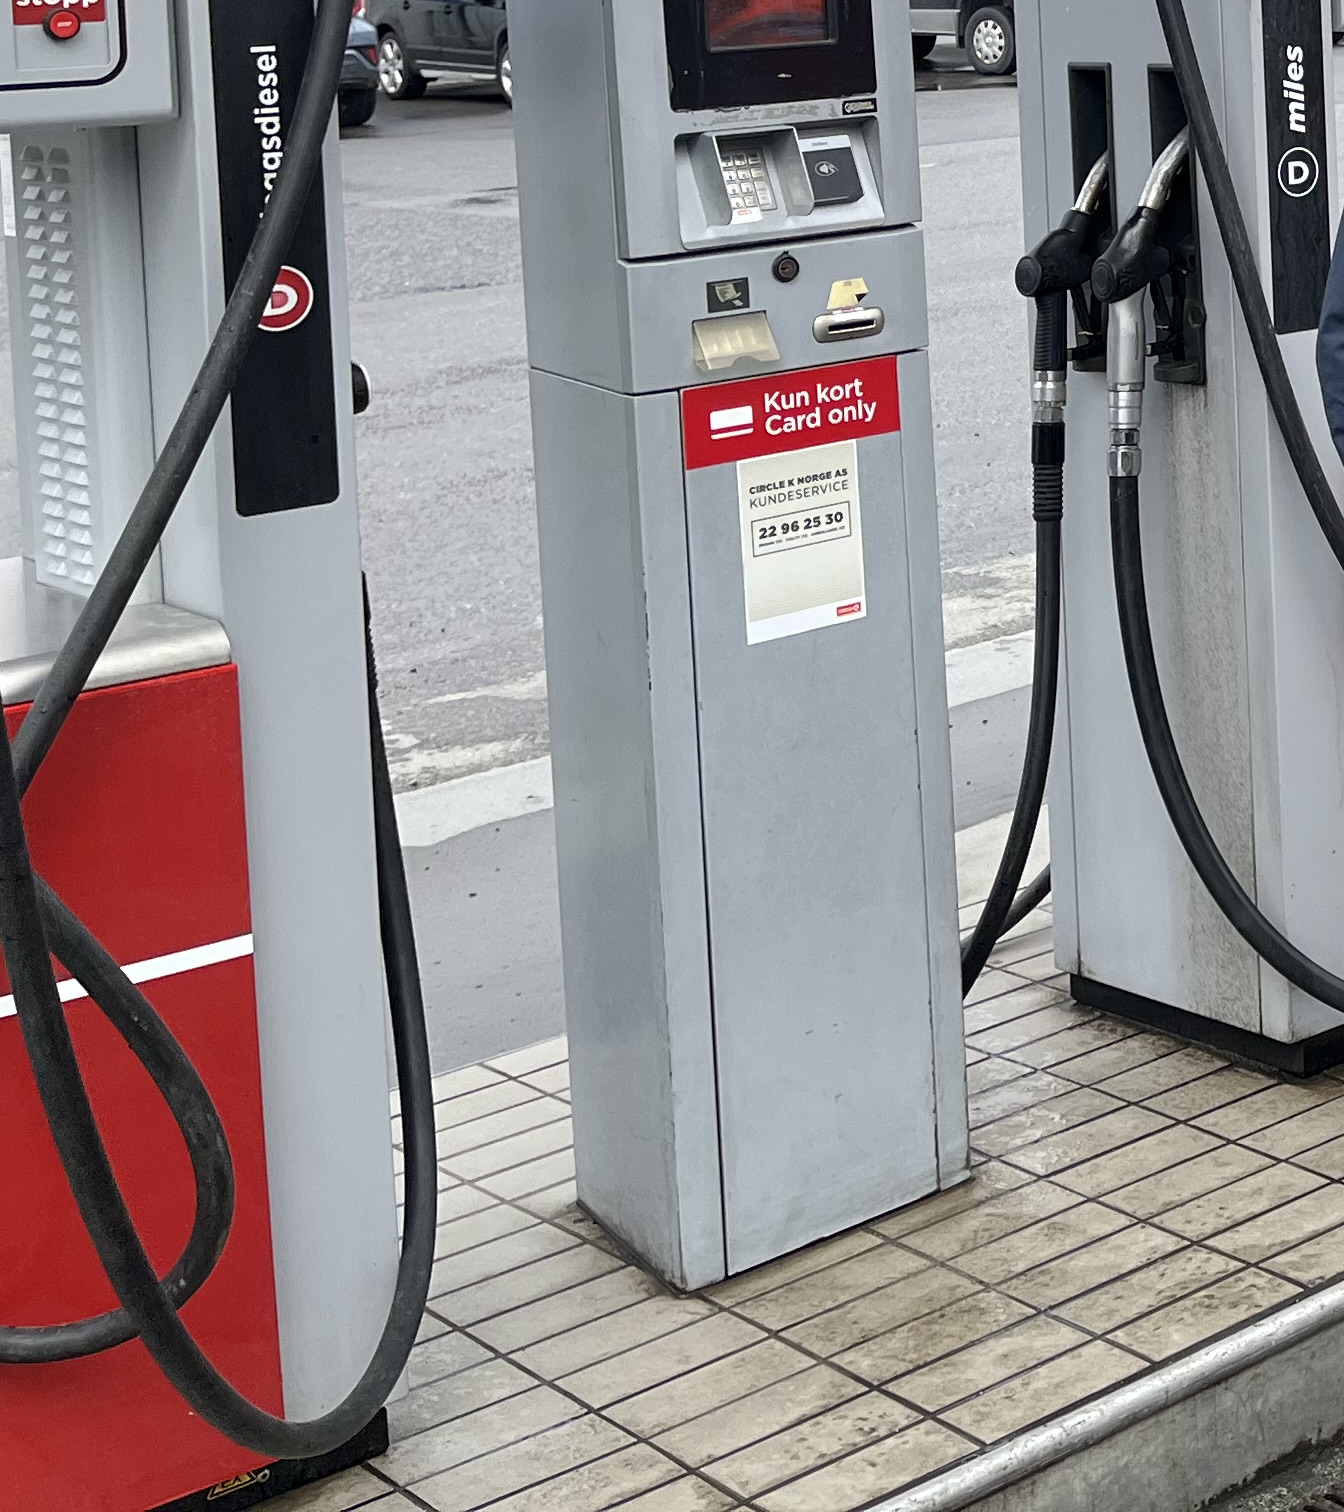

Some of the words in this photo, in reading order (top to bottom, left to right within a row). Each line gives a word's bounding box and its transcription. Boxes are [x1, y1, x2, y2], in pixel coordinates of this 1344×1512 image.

[1282, 44, 1307, 134] miles
[1287, 160, 1310, 186] D
[764, 390, 810, 414] Kun
[816, 378, 863, 403] kort
[765, 406, 822, 436] Card
[828, 399, 877, 425] only
[749, 479, 786, 495] CIRCLE
[787, 477, 796, 488] K
[797, 470, 832, 485] NORGE
[834, 468, 848, 479] AS
[749, 479, 850, 510] KUNDESERVICE
[759, 525, 778, 540] 22
[781, 520, 800, 535] 96
[803, 515, 822, 530] 25
[824, 511, 844, 525] 30
